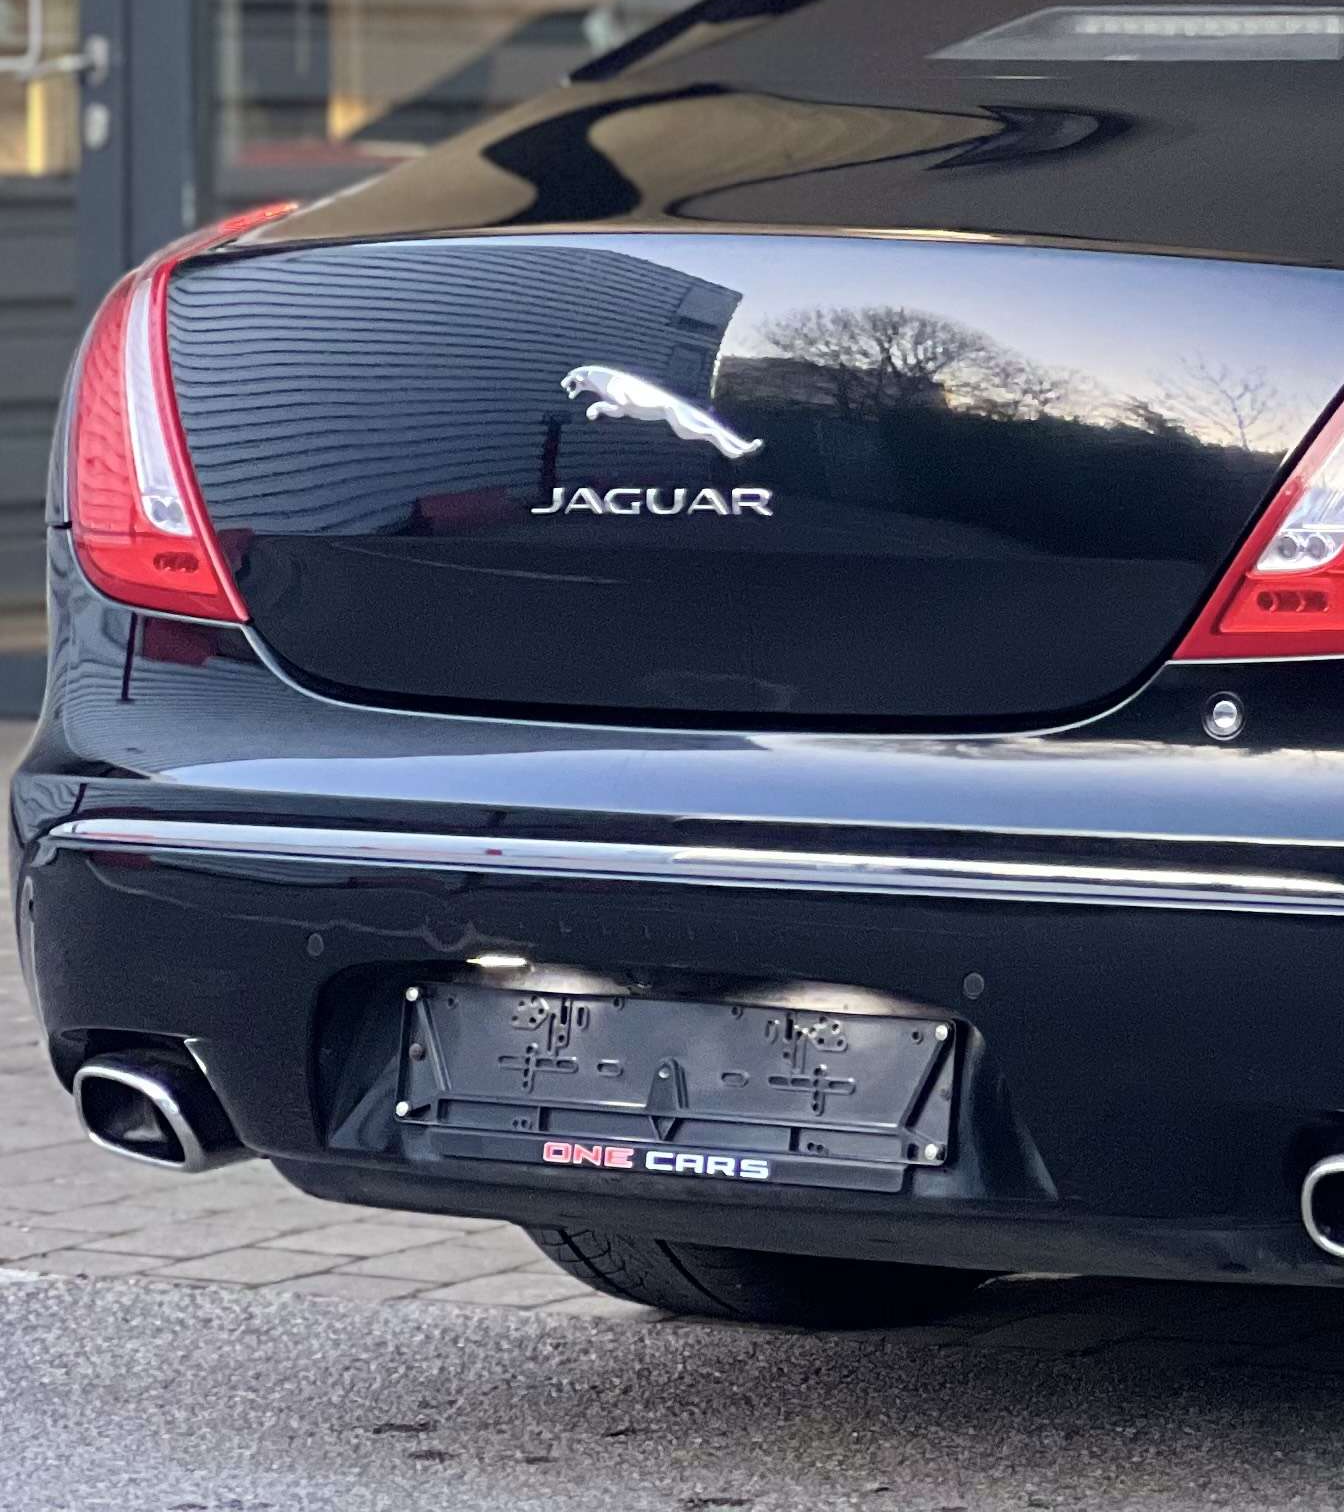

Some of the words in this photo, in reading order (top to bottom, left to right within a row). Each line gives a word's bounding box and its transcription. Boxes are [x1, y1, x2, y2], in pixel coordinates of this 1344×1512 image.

[530, 487, 774, 517] JAGUAR
[541, 1140, 634, 1169] ONE
[645, 1149, 770, 1180] CARS
